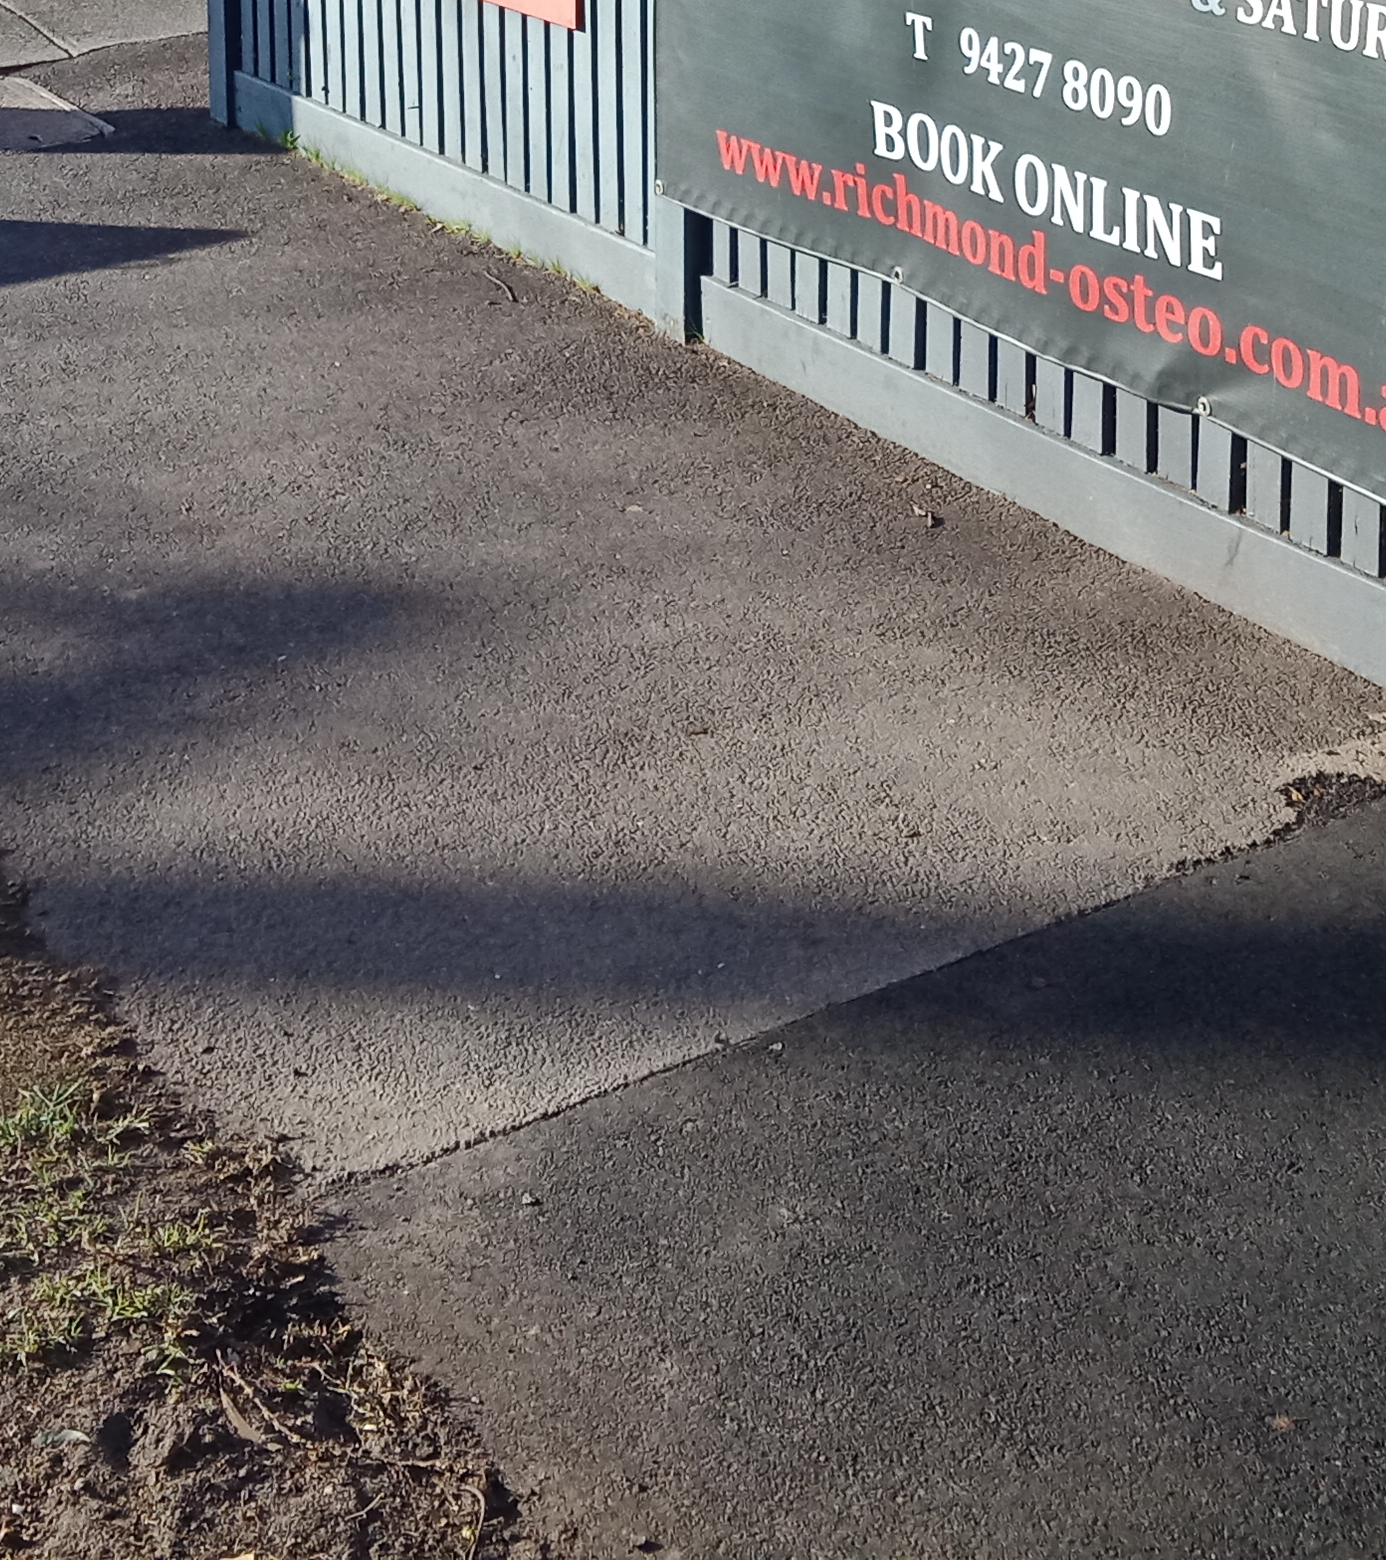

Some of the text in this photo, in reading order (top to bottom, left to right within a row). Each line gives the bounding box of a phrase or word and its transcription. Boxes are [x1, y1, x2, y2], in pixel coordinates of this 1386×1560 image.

[905, 11, 1173, 137] T 9427 8090
[870, 98, 1225, 282] BOOK ONLINE
